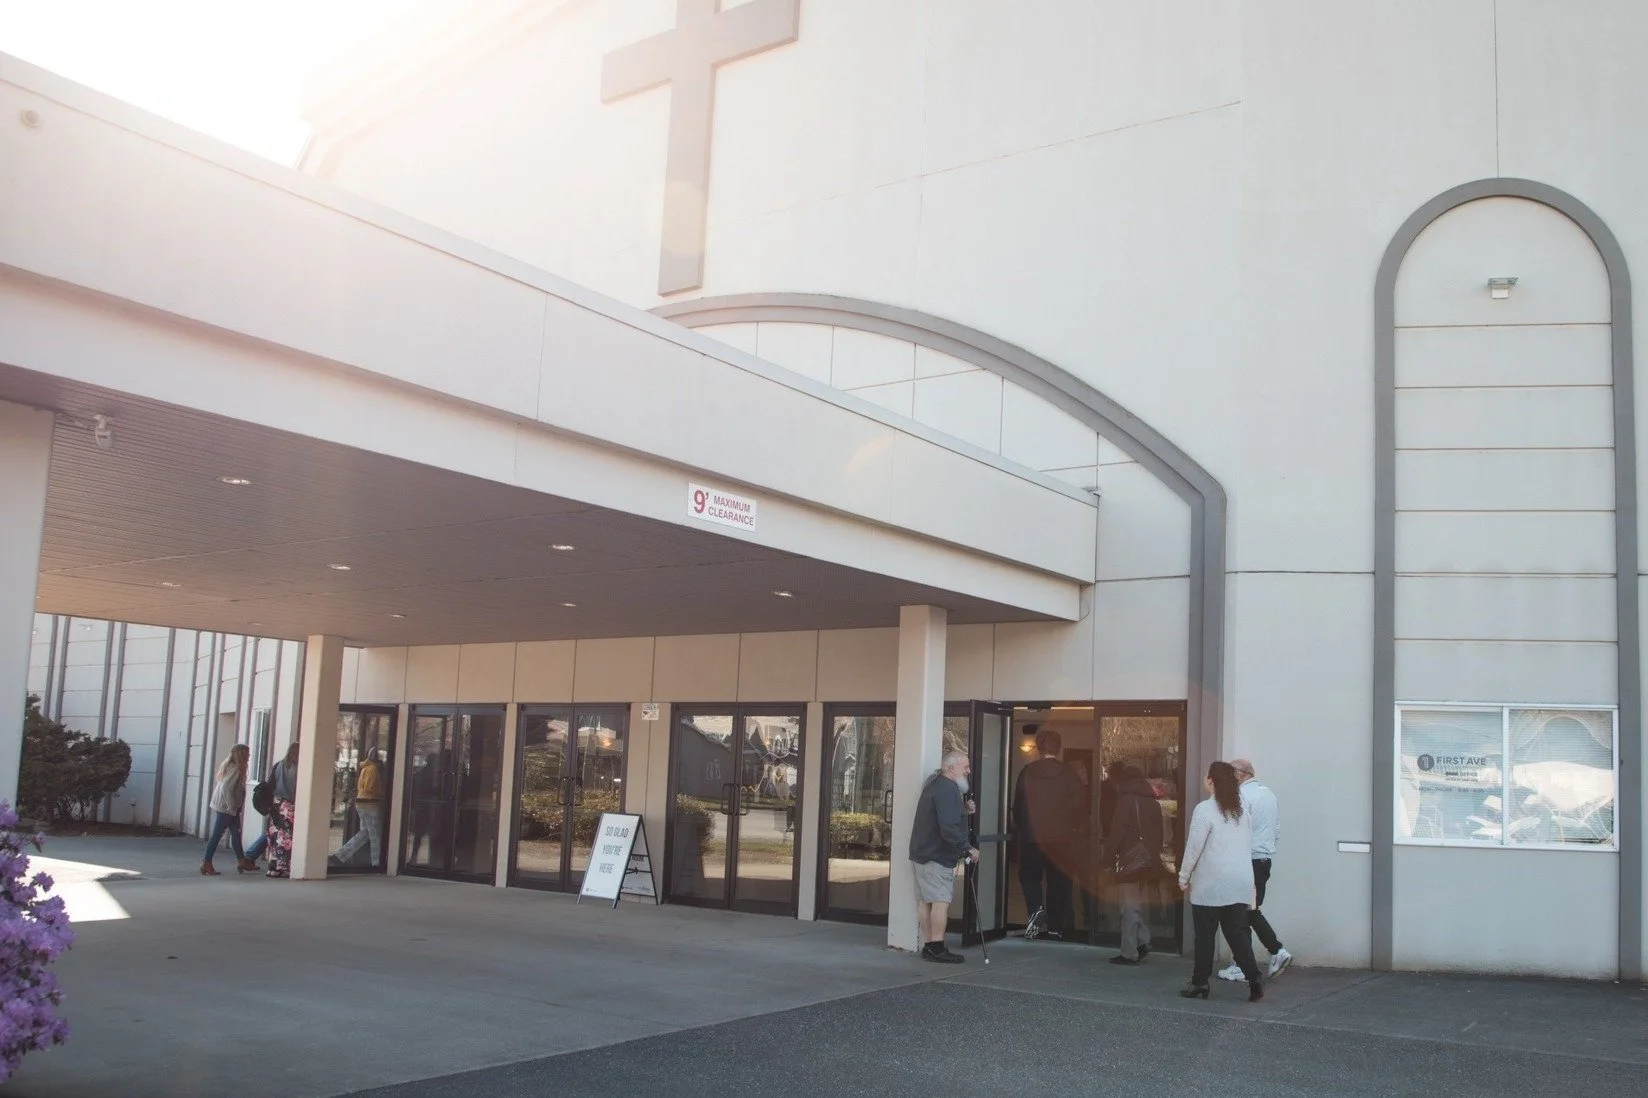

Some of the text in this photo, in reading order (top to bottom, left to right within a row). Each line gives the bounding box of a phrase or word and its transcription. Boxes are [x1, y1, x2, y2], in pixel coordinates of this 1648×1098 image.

[694, 490, 750, 513] 9' MAXIMUM
[708, 507, 754, 526] CLEARANCE
[1436, 756, 1486, 765] FIRST AVE
[605, 826, 629, 838] SO GLAD
[602, 844, 623, 856] YOU'RE
[599, 862, 615, 874] HERE
